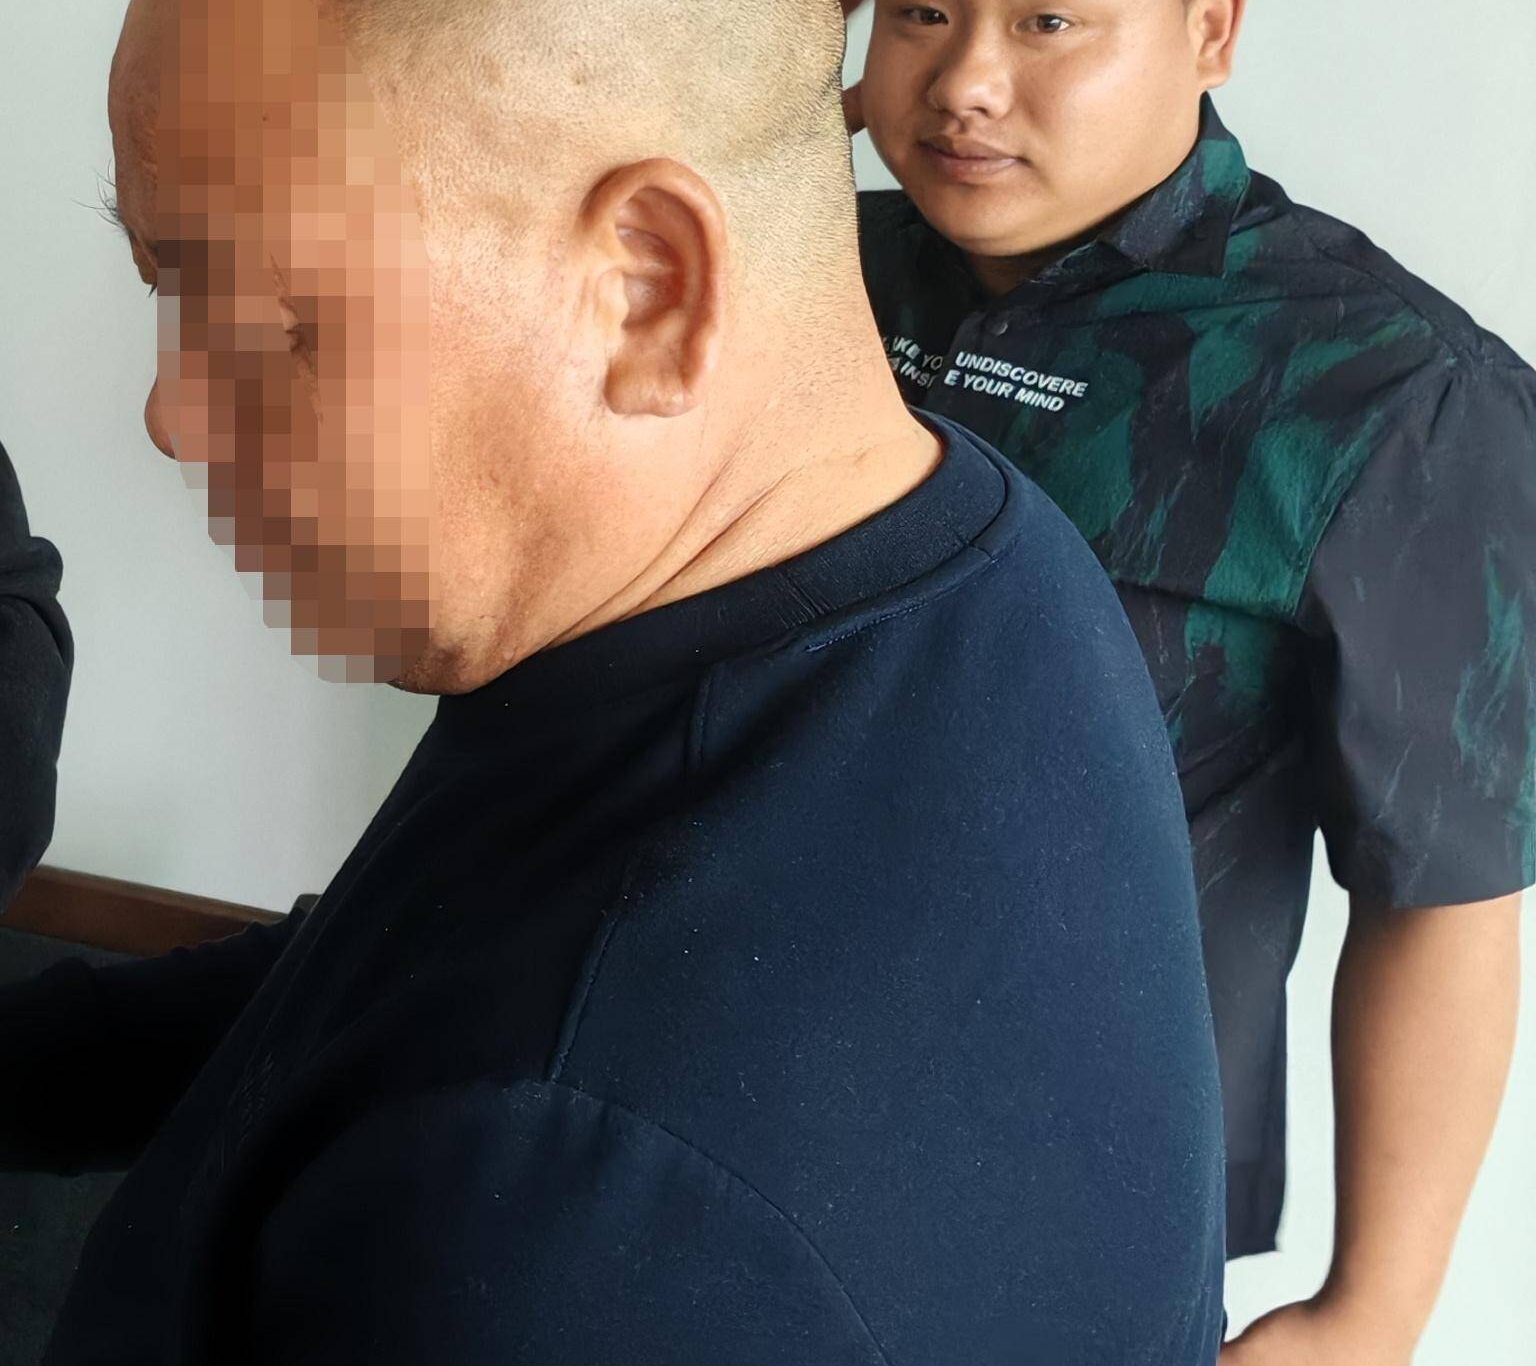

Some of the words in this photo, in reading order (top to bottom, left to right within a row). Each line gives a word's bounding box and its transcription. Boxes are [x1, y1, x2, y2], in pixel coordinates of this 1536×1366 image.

[955, 351, 1088, 398] UNDISCOVERE
[964, 373, 1013, 400] YOUR
[1015, 387, 1065, 413] MIND
